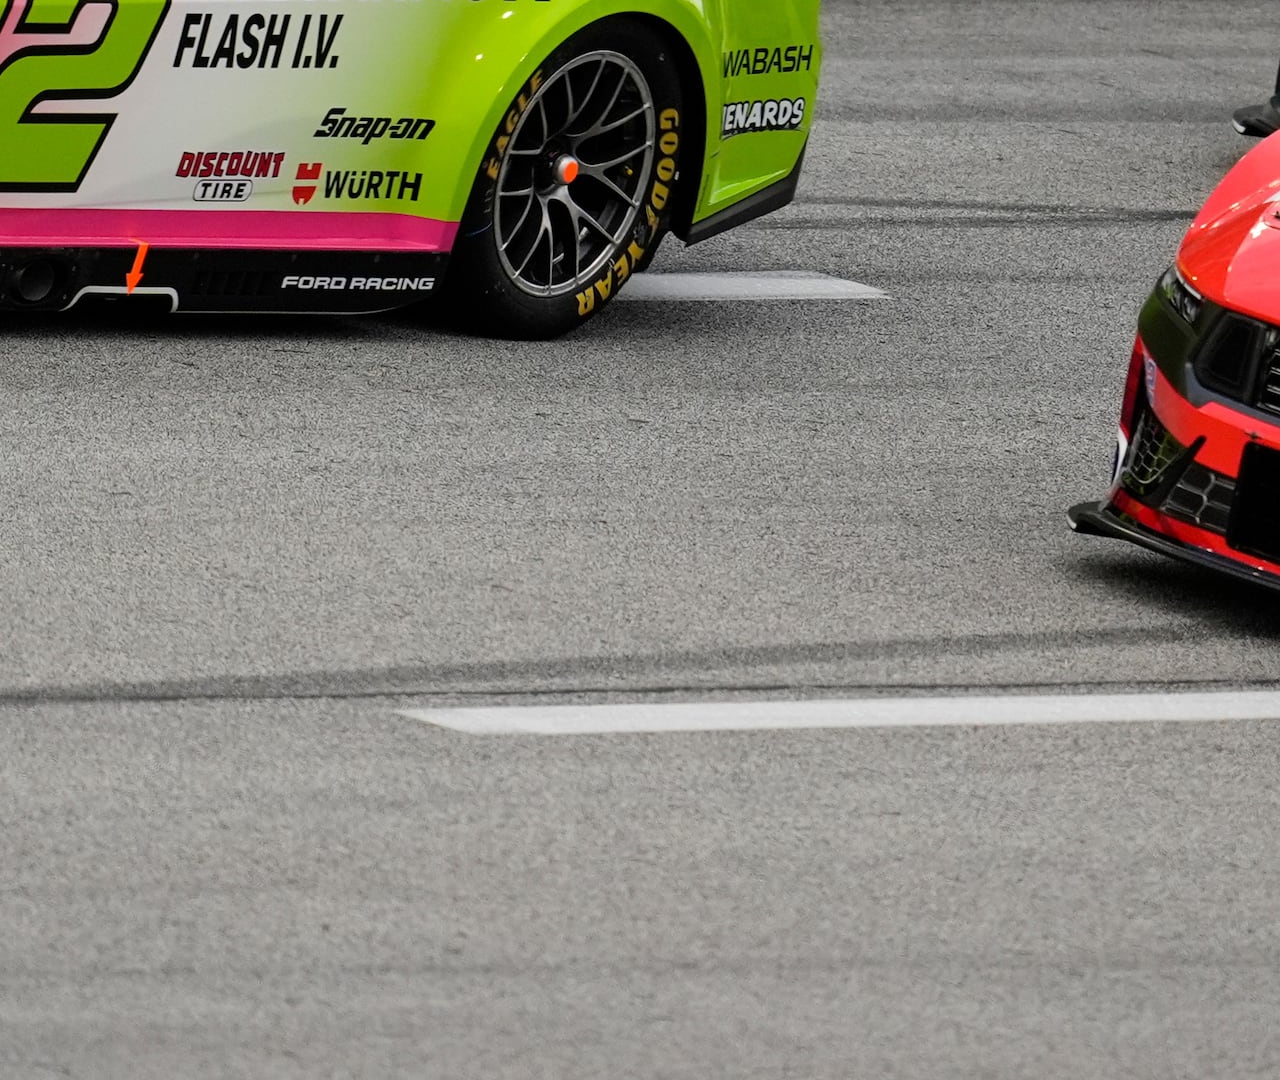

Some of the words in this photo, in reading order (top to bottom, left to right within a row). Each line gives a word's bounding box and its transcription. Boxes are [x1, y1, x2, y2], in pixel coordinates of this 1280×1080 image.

[173, 13, 294, 69] FLASH
[290, 14, 345, 69] I.V.
[723, 44, 813, 78] WABASH
[313, 107, 436, 145] Snap-on
[487, 69, 545, 181] EAGLE
[723, 98, 805, 132] ENARDS
[175, 150, 286, 178] DISCOUNT
[201, 182, 248, 199] TIRE
[281, 276, 347, 290] FORD
[349, 276, 435, 291] RACING
